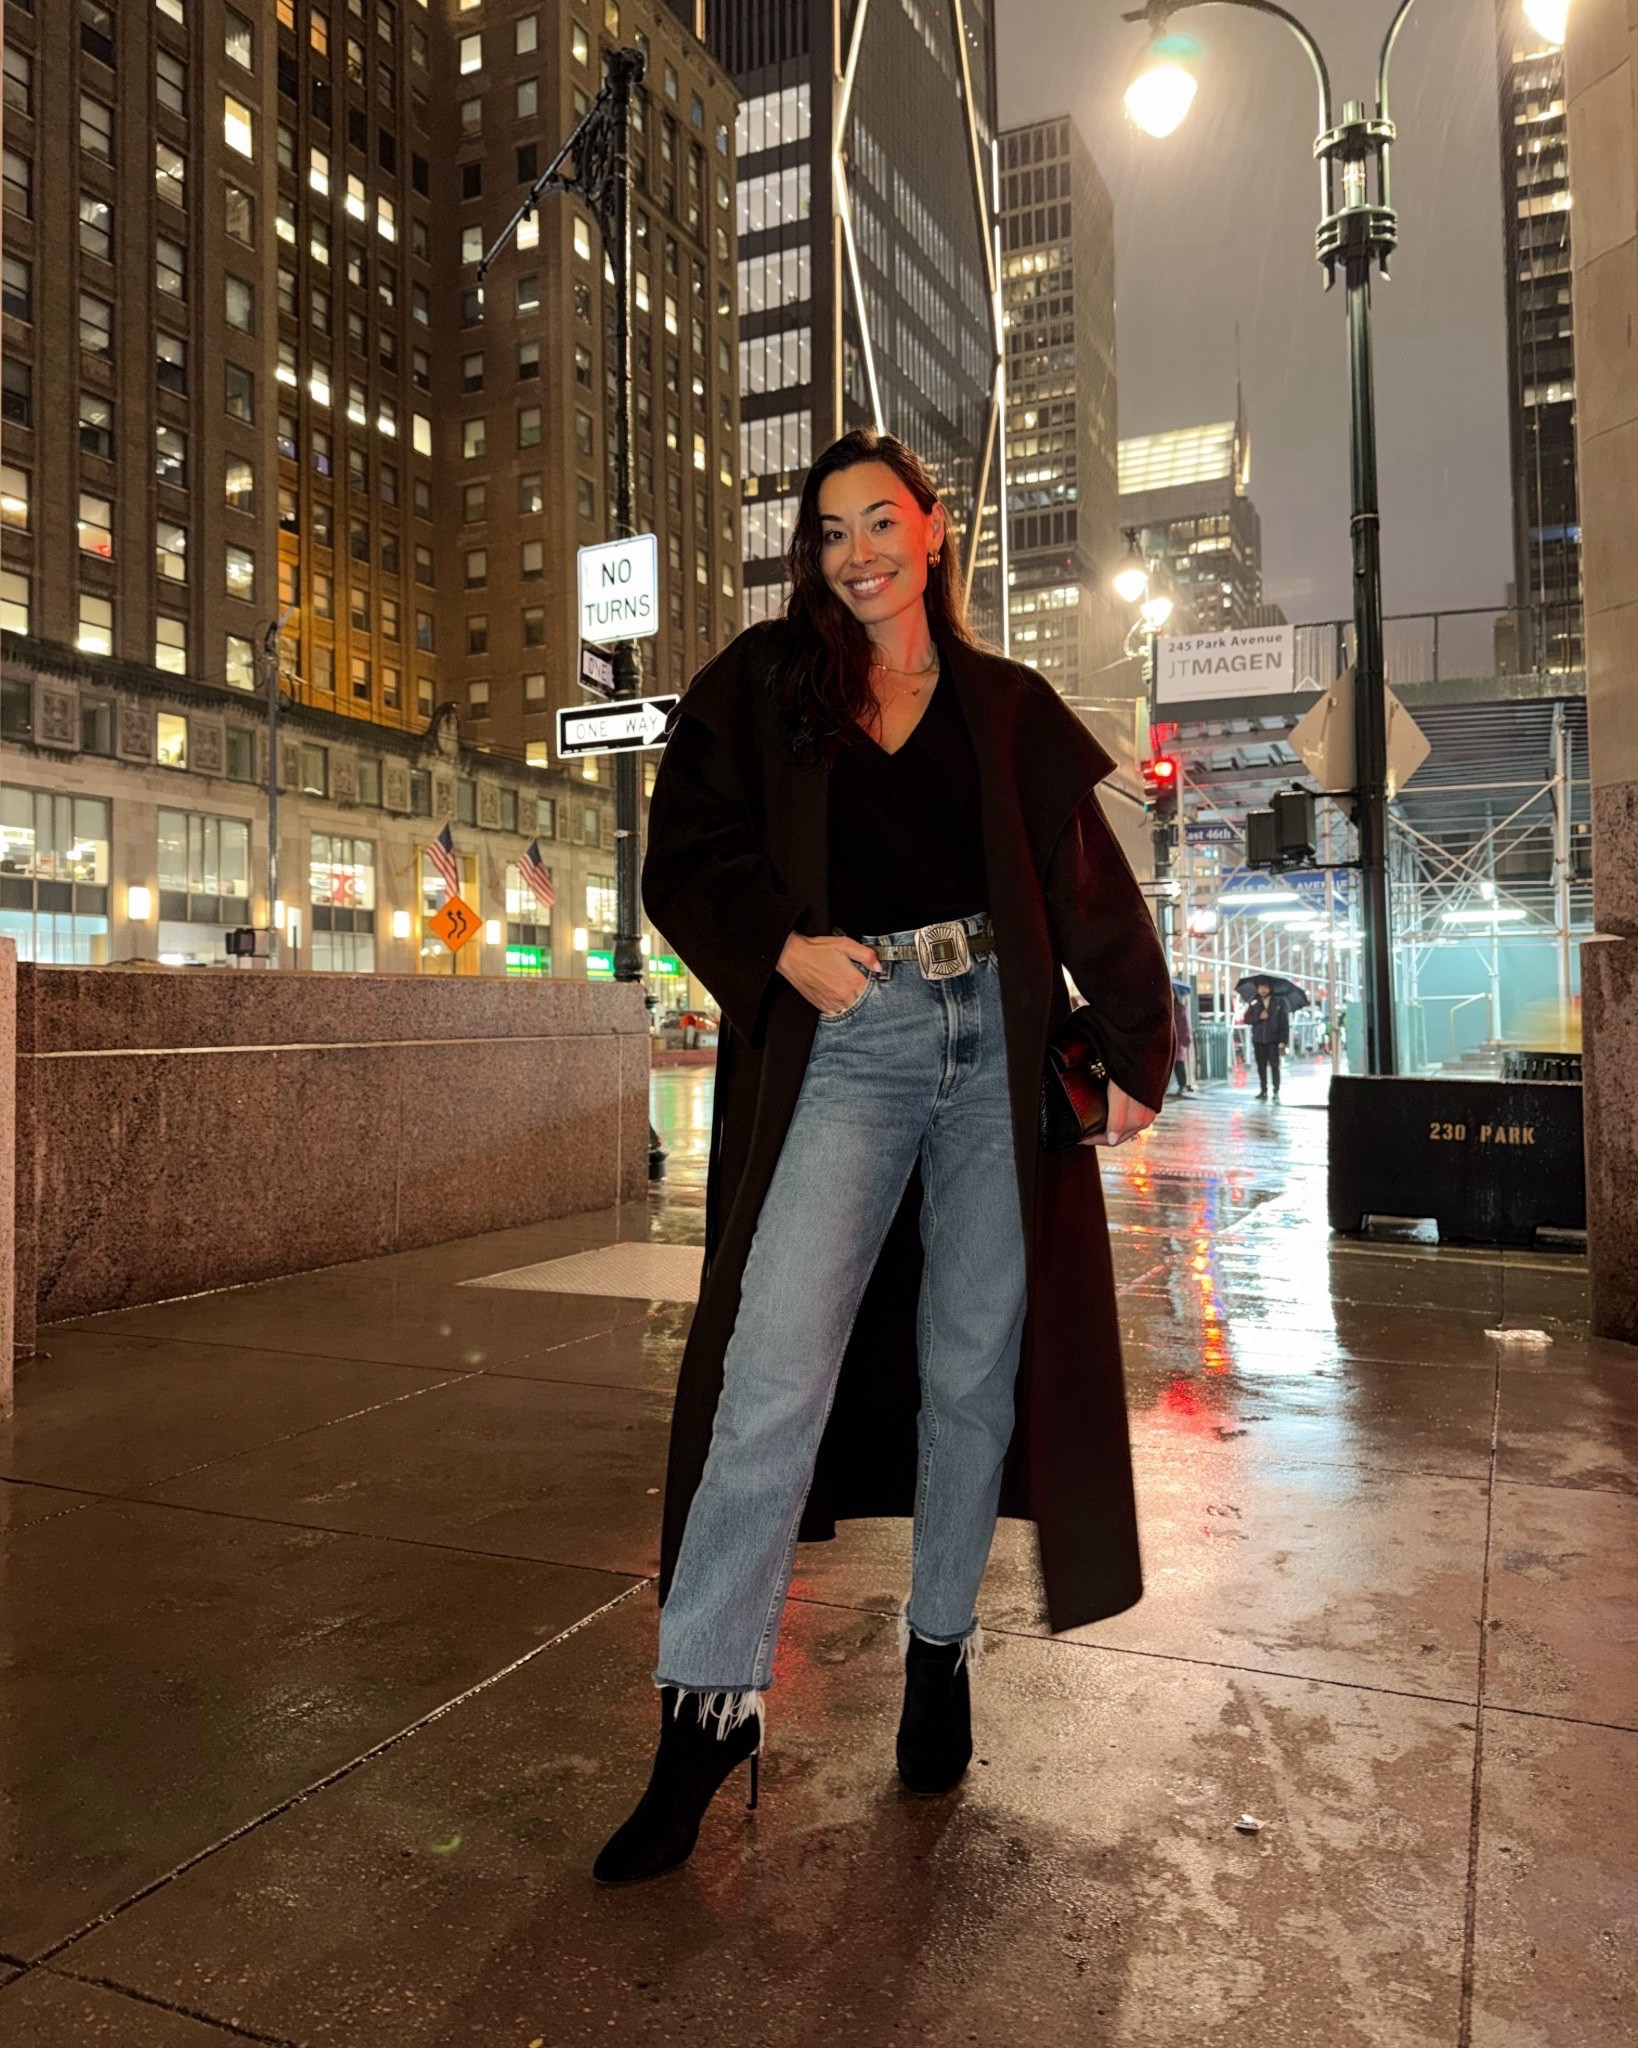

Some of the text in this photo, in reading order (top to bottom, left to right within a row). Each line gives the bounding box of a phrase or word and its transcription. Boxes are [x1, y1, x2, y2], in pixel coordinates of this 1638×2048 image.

[602, 558, 632, 588] NO
[584, 594, 650, 626] TURNS
[1168, 634, 1283, 653] 245 Park Avenue
[588, 657, 608, 682] ONE
[1168, 651, 1283, 678] JTMAGEN
[576, 715, 658, 740] ONE WAY
[1183, 829, 1204, 841] ast
[1205, 828, 1232, 841] 46th
[1429, 1122, 1535, 1144] 230 PARK
